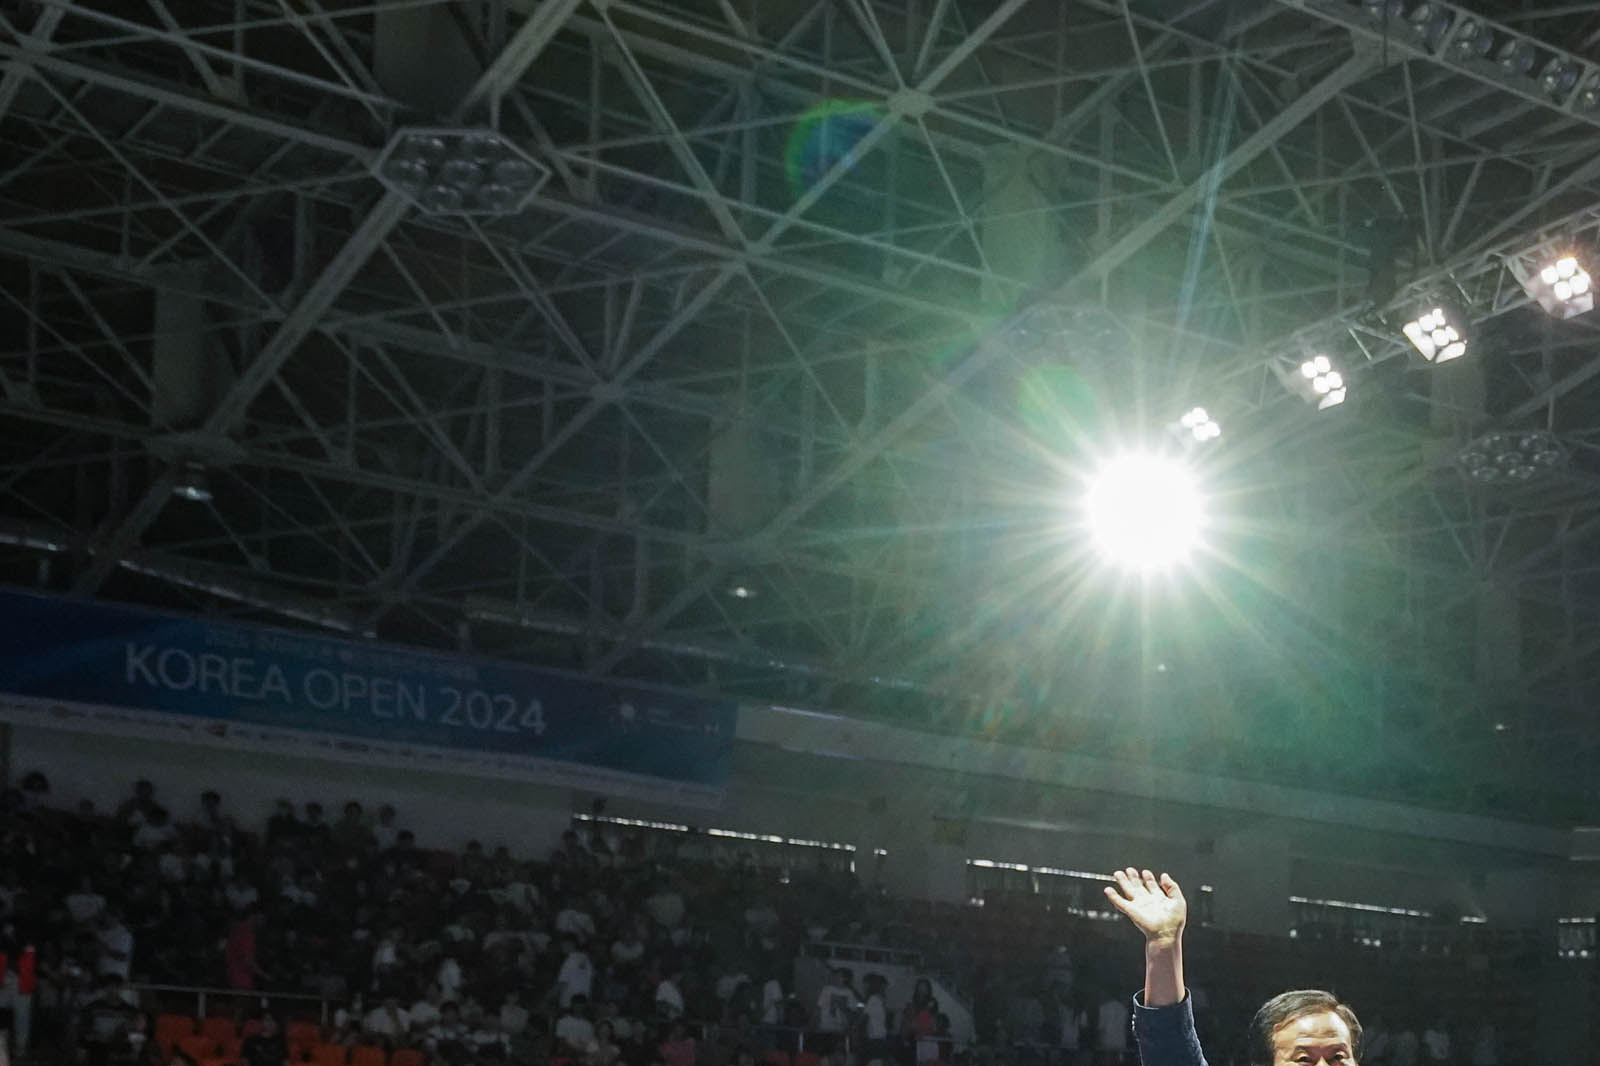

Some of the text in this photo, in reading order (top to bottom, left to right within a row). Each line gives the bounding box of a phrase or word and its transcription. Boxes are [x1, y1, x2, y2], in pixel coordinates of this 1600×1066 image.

[123, 642, 293, 705] KOREA
[303, 667, 428, 722] OPEN
[439, 686, 548, 736] 2024
